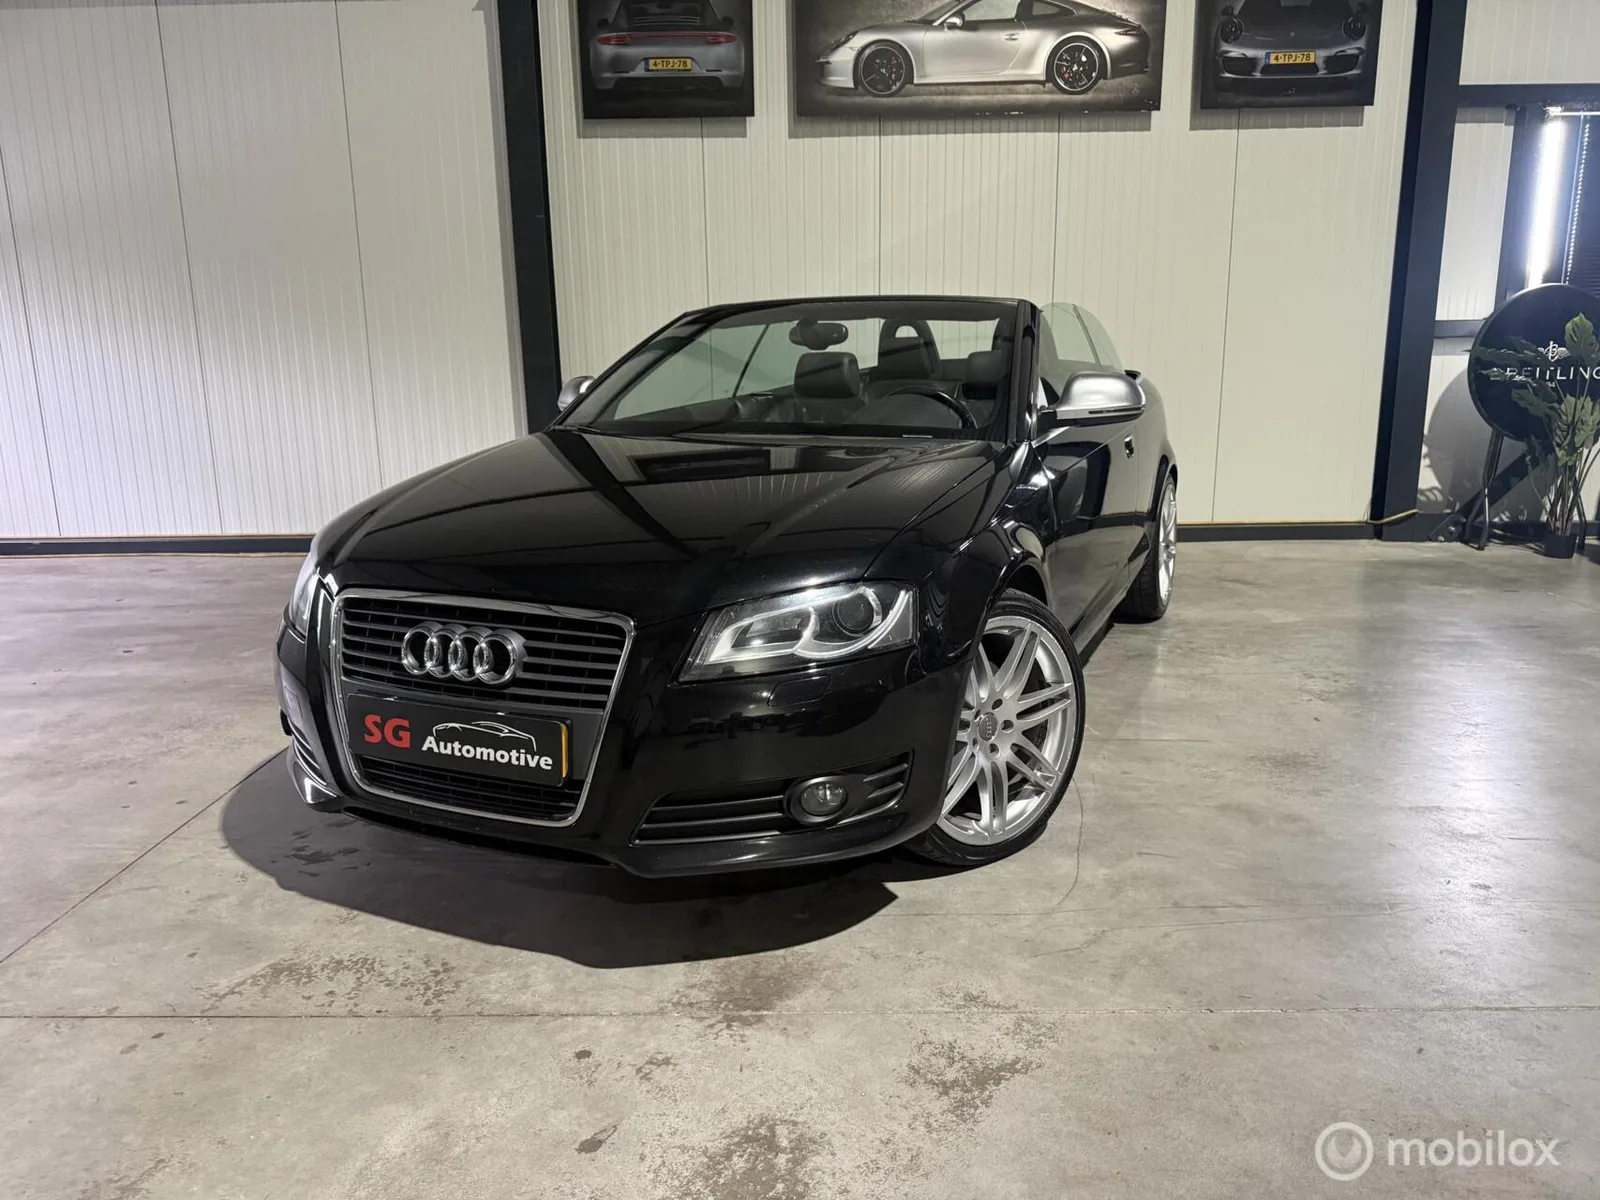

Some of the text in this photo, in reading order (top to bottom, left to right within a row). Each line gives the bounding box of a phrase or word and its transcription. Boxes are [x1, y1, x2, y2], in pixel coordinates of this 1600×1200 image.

[1273, 53, 1311, 63] 4-TPJ-78
[364, 714, 553, 770] SG Automotive
